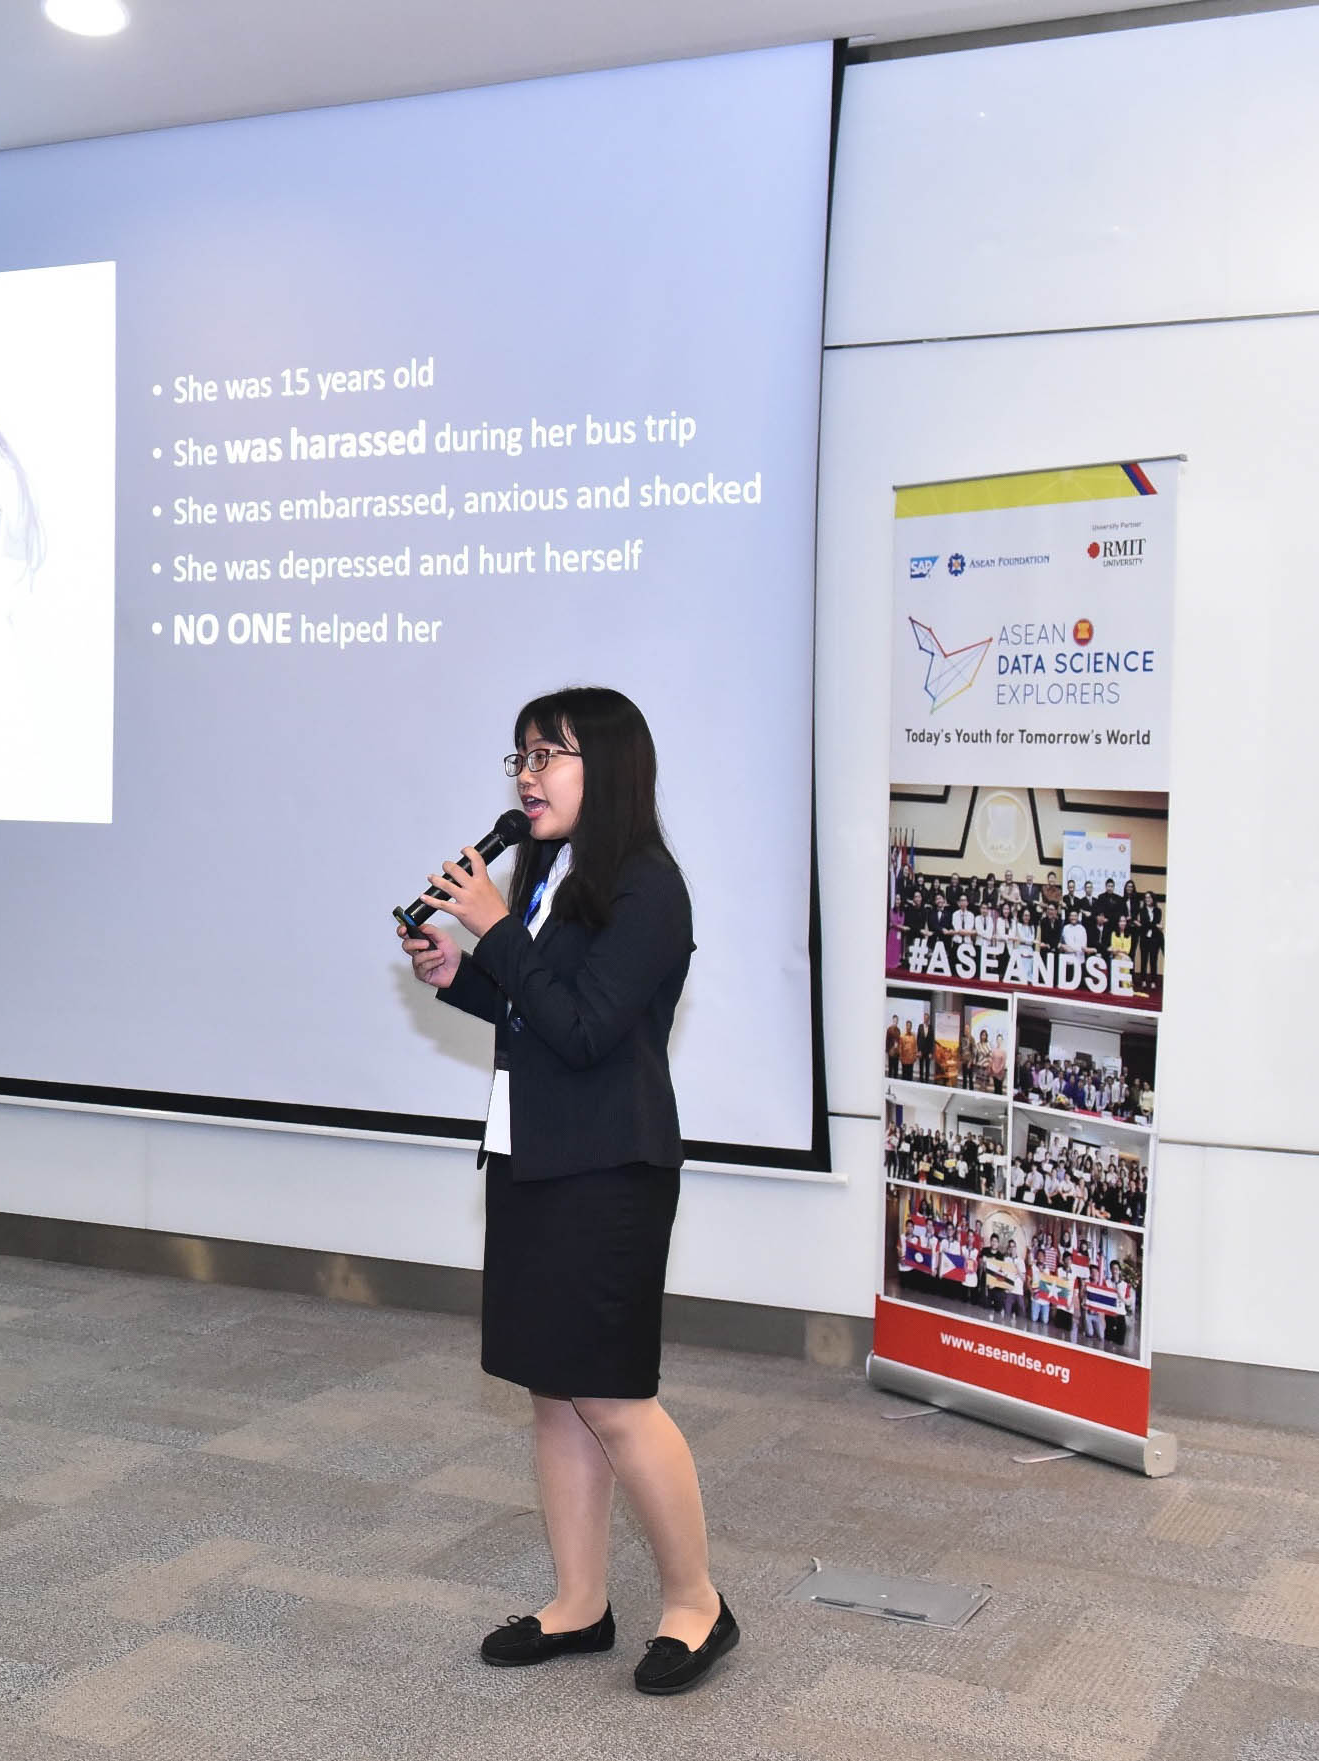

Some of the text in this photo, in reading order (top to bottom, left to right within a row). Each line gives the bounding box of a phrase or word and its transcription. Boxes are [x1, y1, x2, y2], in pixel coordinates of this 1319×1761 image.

[173, 357, 434, 403] She was 15 years old
[173, 411, 696, 466] She was harassed during her bus trip
[173, 472, 761, 525] She was embarrassed, anxious and shocked
[173, 539, 643, 584] She was depressed and hurt herself
[1103, 538, 1146, 558] RMIT
[1103, 558, 1143, 567] UNIVERSITY
[910, 558, 934, 577] SAP
[173, 612, 441, 649] NO ONE helped her
[998, 623, 1065, 645] ASEAN
[998, 651, 1154, 674] DATA SCIENCE
[997, 683, 1120, 704] EXPLORERS
[905, 729, 1150, 745] Today's Youth for Tomorrow's World
[909, 938, 1134, 996] #ASEANDSE
[941, 1331, 1070, 1384] www.aseandse.org
